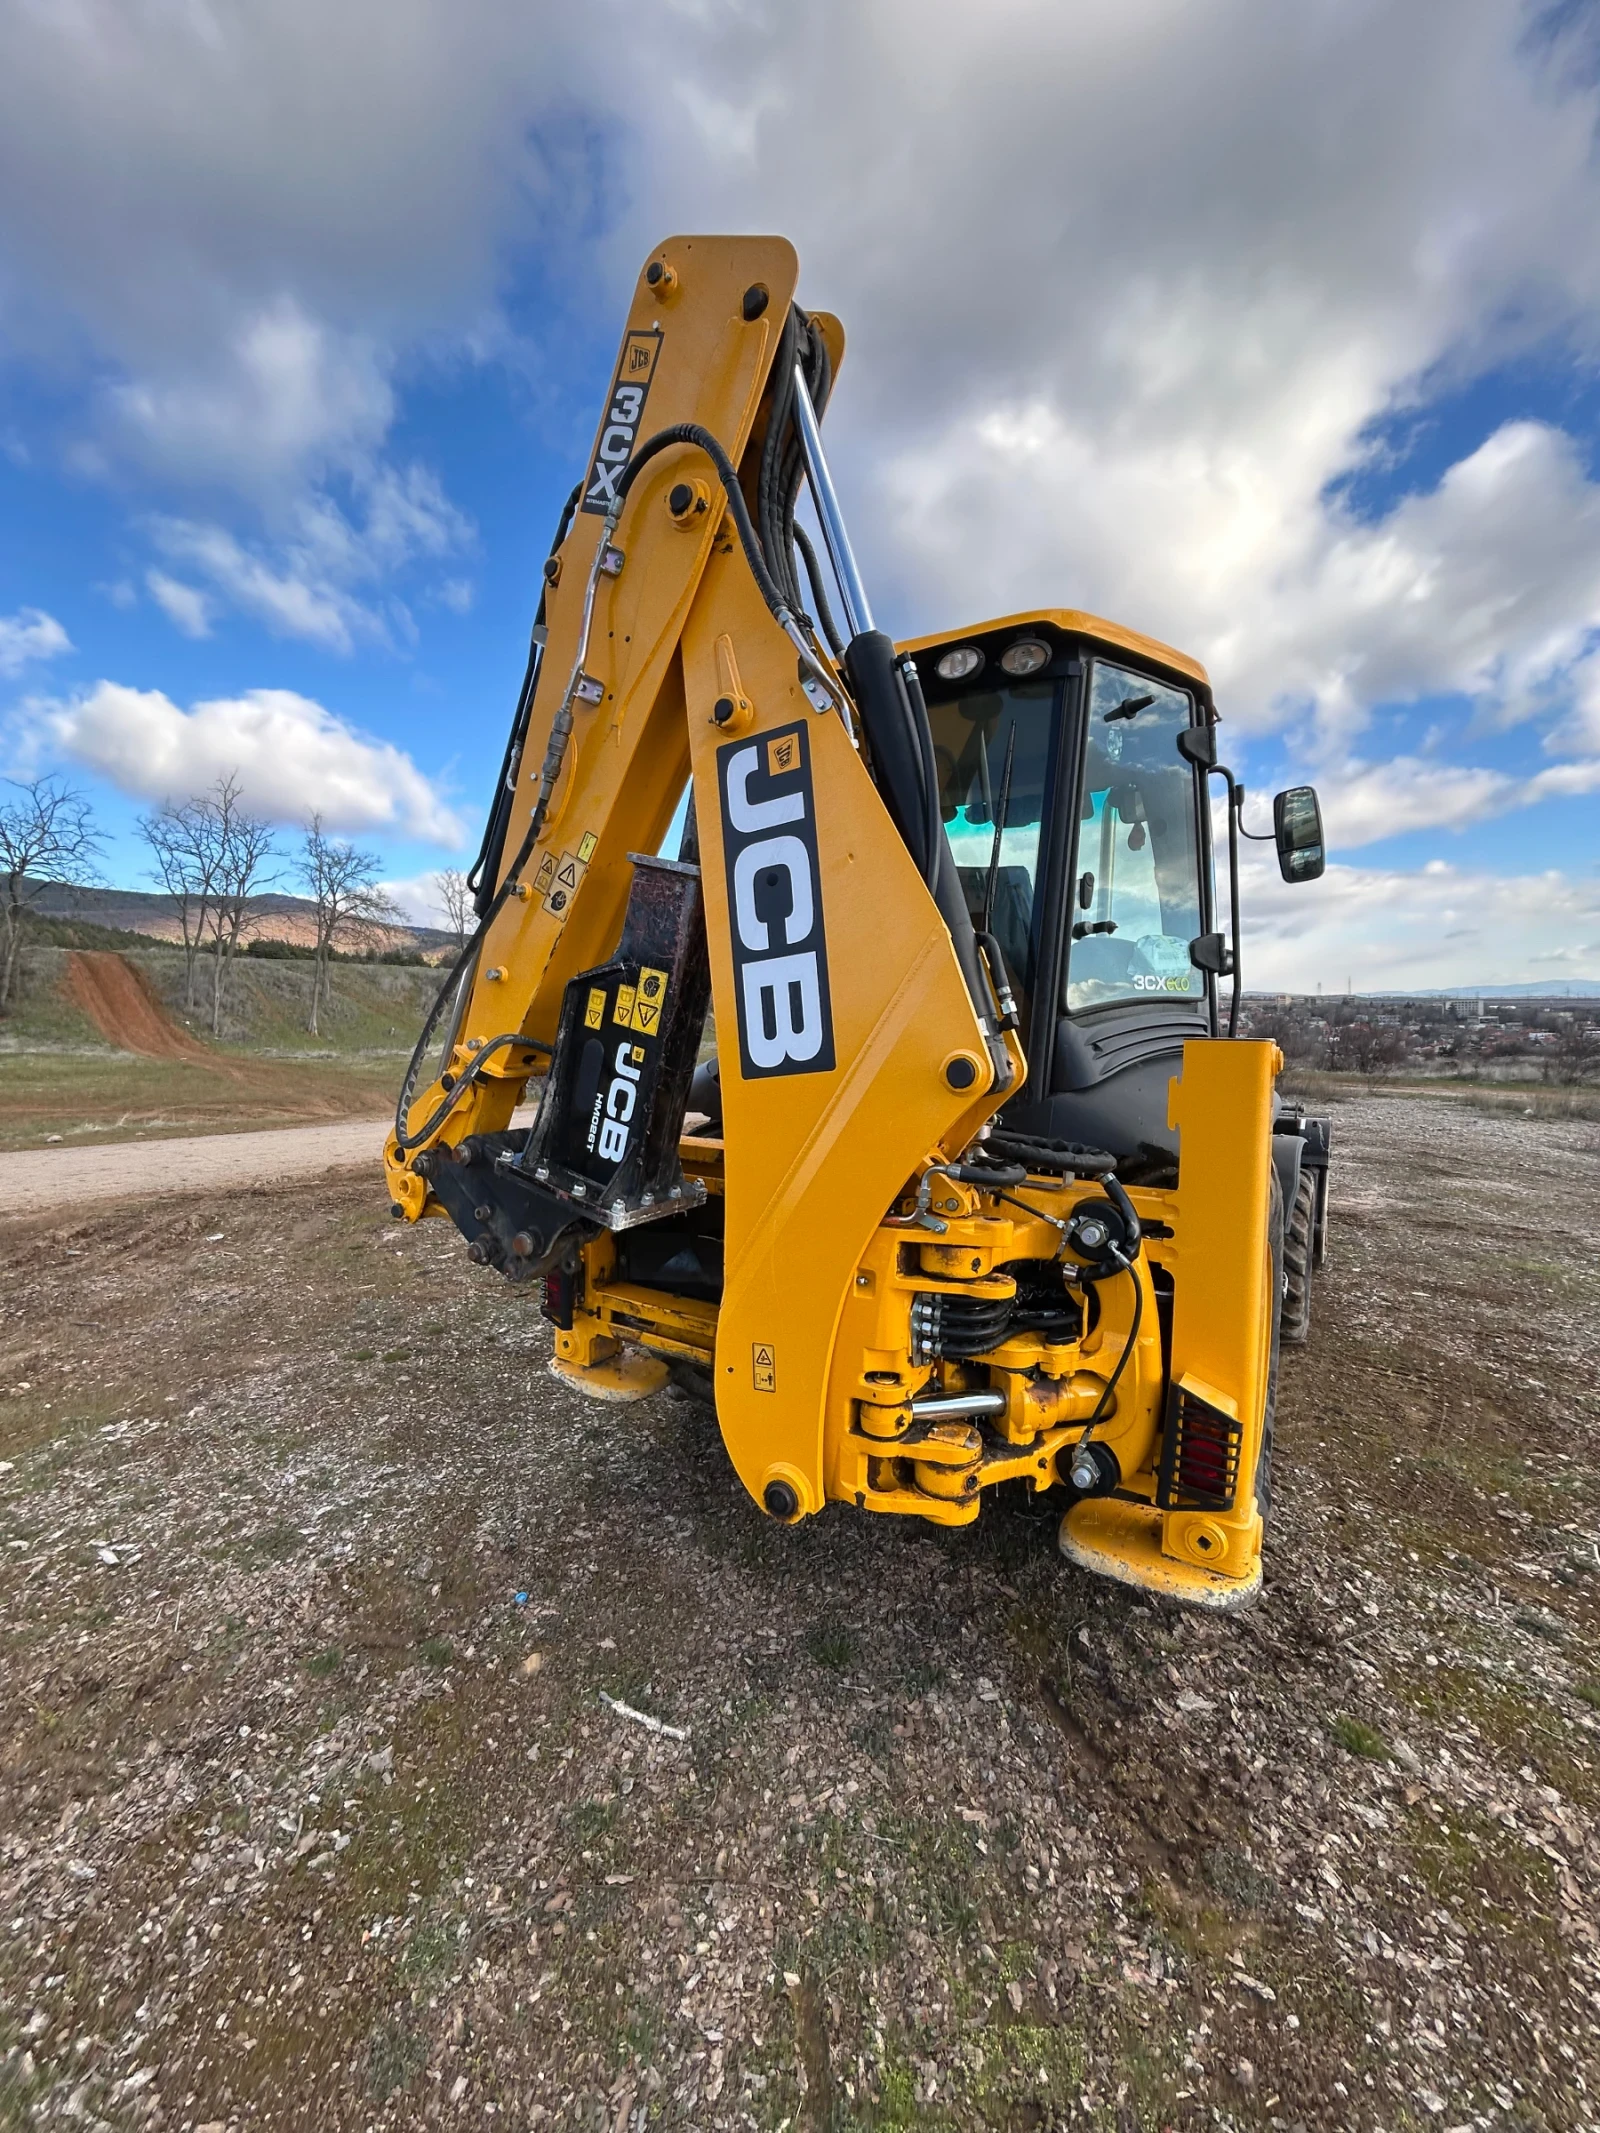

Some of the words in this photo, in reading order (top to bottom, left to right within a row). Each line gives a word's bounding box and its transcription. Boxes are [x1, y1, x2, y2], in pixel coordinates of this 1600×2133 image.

[631, 348, 649, 370] JCB
[587, 386, 644, 499] 3CX
[585, 498, 611, 507] SITEMAST
[776, 743, 791, 767] JCB
[726, 745, 823, 1068] JCB
[598, 1042, 641, 1163] JCB
